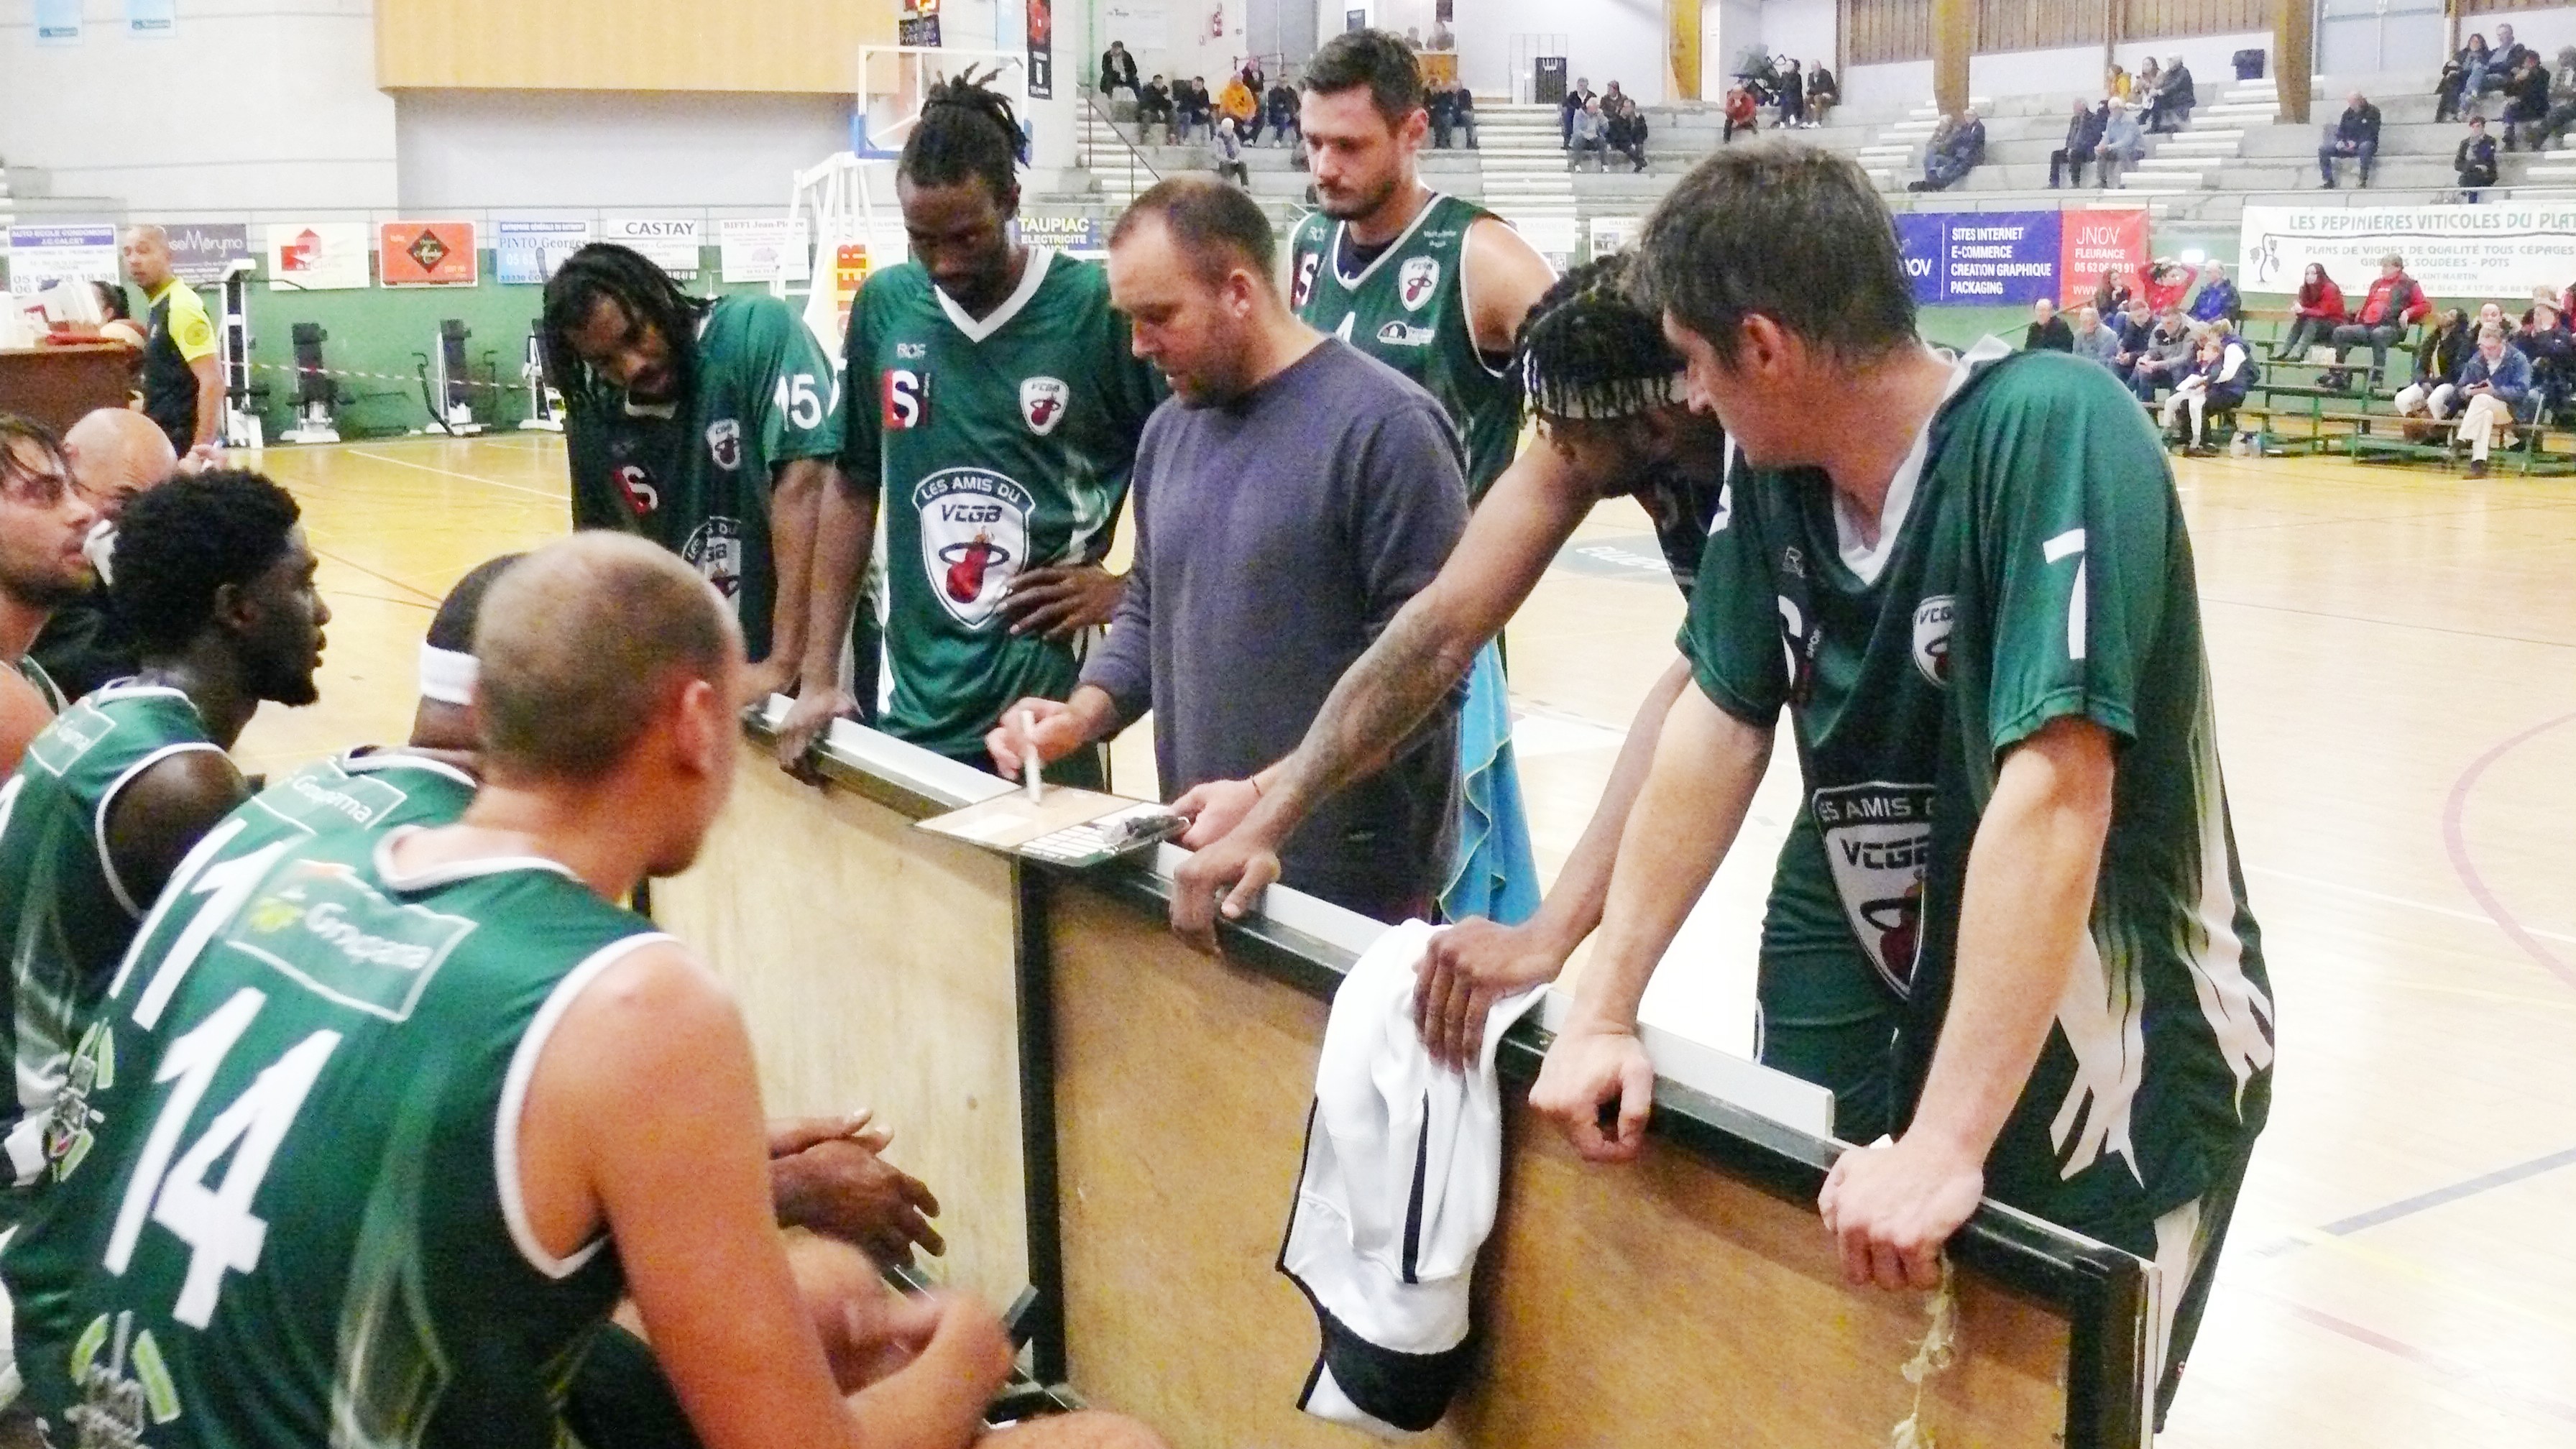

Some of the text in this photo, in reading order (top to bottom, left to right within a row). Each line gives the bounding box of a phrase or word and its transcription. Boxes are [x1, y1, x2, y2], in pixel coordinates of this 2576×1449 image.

[625, 222, 694, 235] CASTAY
[1017, 217, 1089, 232] TAUPIAC
[2289, 213, 2576, 230] LES PEPINIERES VITICOLES DU PLAT
[1021, 234, 1087, 244] ELECTRICITE
[1951, 227, 2024, 241] SITES INTERNET
[2076, 226, 2121, 245] JNOV
[500, 237, 537, 248] PINTO
[2305, 246, 2340, 254] PLANS
[2342, 246, 2358, 254] DE
[2363, 246, 2404, 254] VIGNES
[2409, 246, 2423, 254] DE
[2428, 244, 2479, 254] QUALITÉ
[2484, 245, 2513, 254] TOUS
[1951, 246, 2012, 259] E-COMMERCE
[2075, 249, 2125, 259] FLEURANCE
[1951, 262, 2052, 277] CREATION GRAPHIQUE
[2074, 263, 2085, 272] 05
[2087, 263, 2097, 272] 62
[2124, 263, 2134, 273] 91
[2480, 258, 2510, 267] POTS
[13, 275, 30, 284] 05
[1950, 281, 2003, 295] PACKAGING
[774, 373, 822, 432] 15
[921, 477, 1021, 503] LES AMIS DU
[941, 504, 1003, 523] VCGB
[2043, 528, 2086, 660] 7
[1919, 607, 1954, 625] VCG
[1846, 796, 1912, 819] AMIS
[109, 818, 291, 1031] 11
[104, 986, 343, 1330] 14
